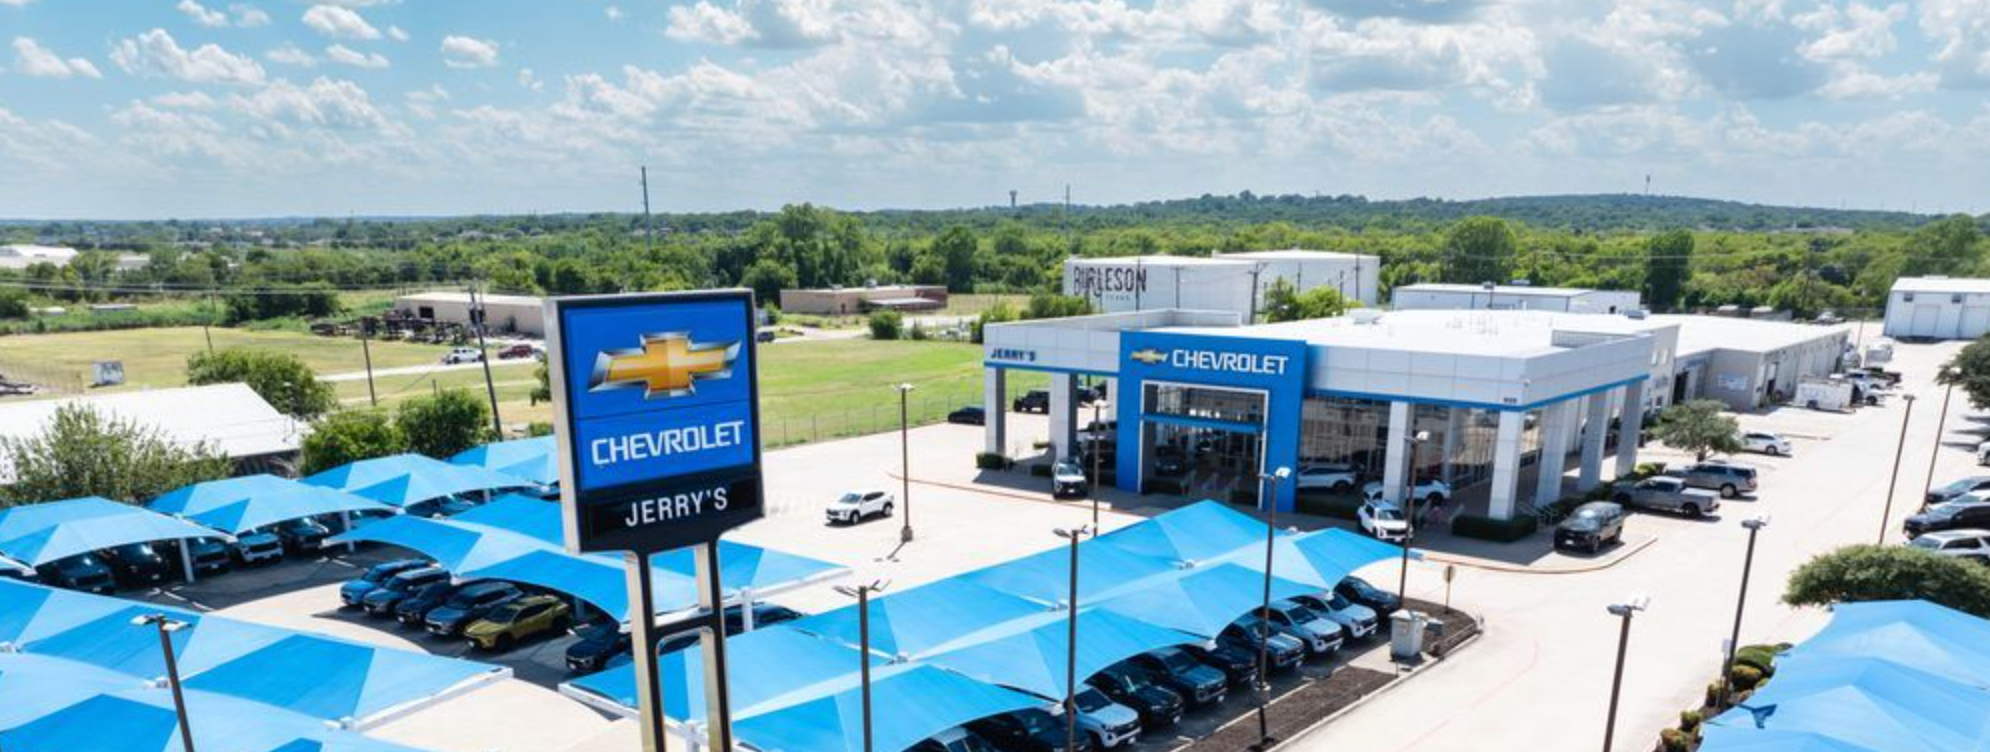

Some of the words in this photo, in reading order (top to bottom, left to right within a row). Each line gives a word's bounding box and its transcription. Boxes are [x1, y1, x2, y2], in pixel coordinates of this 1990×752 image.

[1074, 266, 1147, 298] BURLESON
[1172, 349, 1288, 374] CHEVROLET
[591, 421, 744, 465] CHEVROLET
[625, 487, 728, 527] JERRY'S
